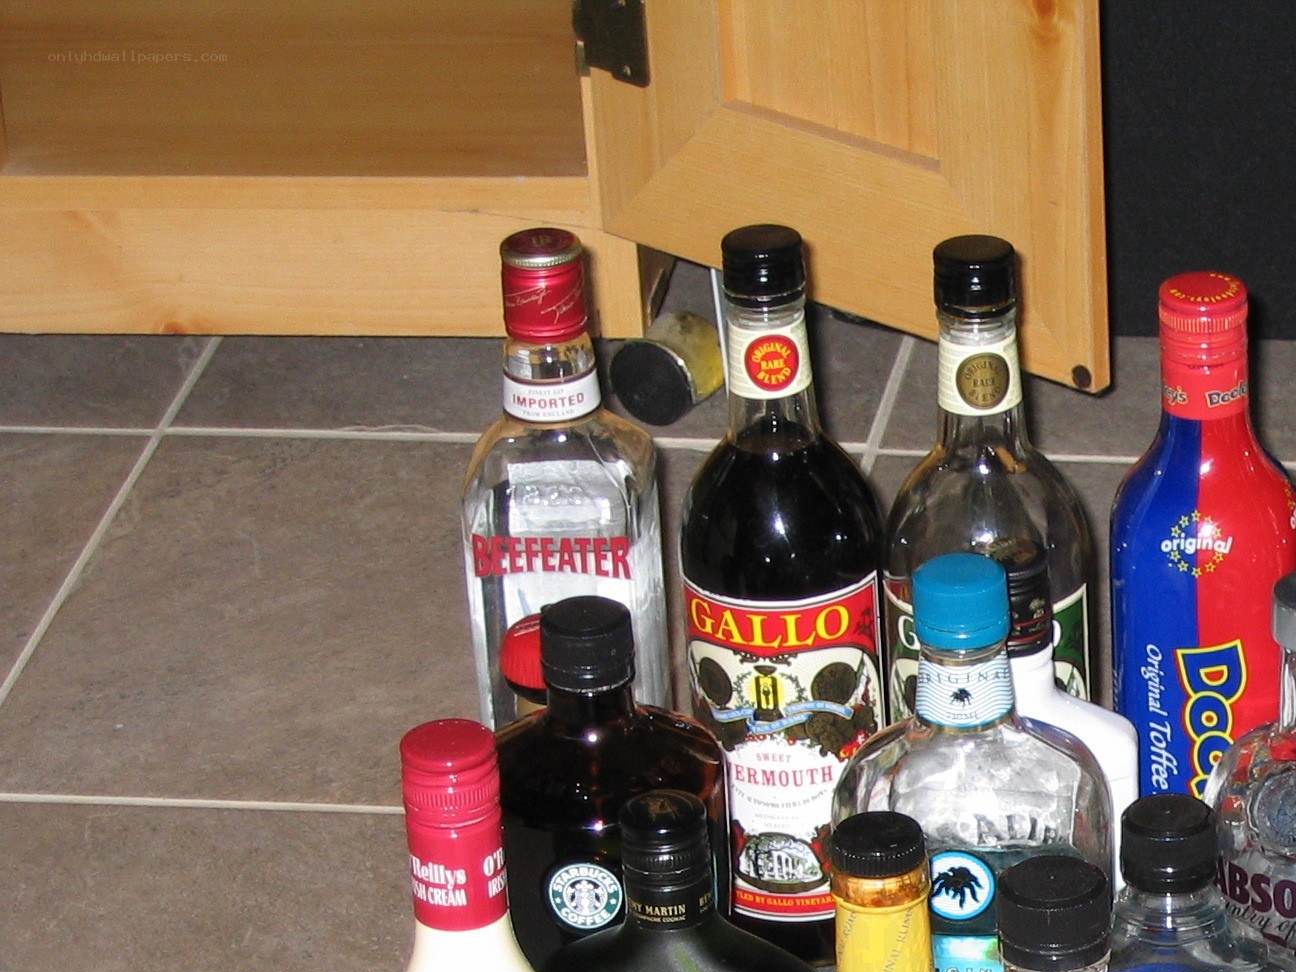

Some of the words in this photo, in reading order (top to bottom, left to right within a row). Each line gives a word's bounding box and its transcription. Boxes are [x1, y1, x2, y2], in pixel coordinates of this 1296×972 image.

[752, 342, 791, 363] ORIGINAL
[760, 359, 786, 370] RARE
[757, 367, 791, 385] BLEND
[512, 392, 585, 410] IMPORTED
[1161, 536, 1233, 554] original
[471, 533, 632, 579] BEEFEATER
[690, 598, 850, 648] GALLO
[1141, 644, 1162, 715] Original
[756, 752, 791, 763] SWEET
[1149, 719, 1178, 790] Toffee
[730, 763, 834, 788] ERMOUTH
[487, 872, 507, 898] IRIS
[552, 867, 617, 893] STARBUCKS
[427, 888, 467, 907] CREAM
[560, 907, 611, 926] COFFEE
[645, 903, 686, 916] MARTIN
